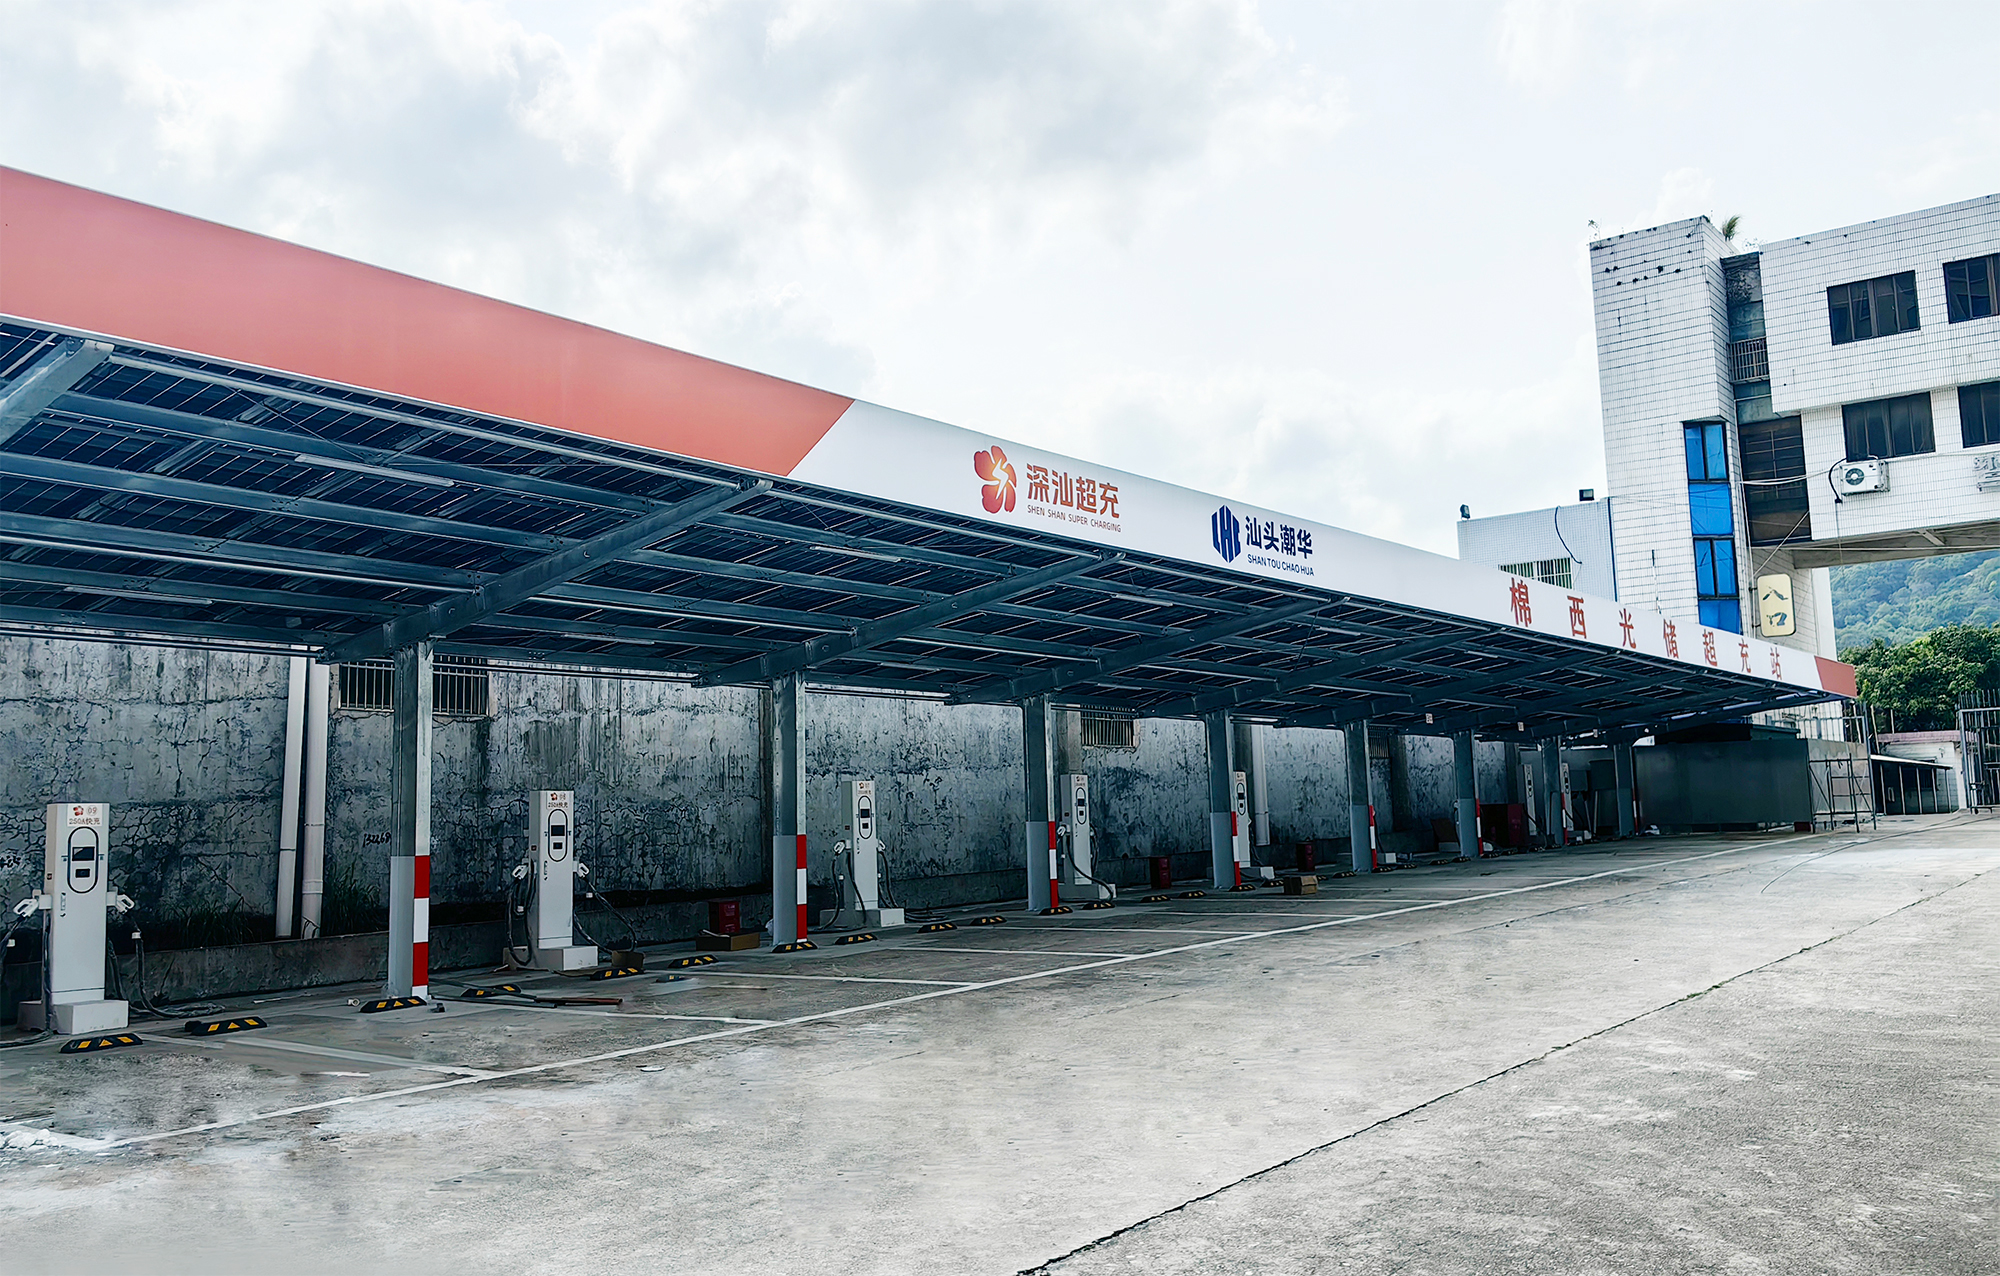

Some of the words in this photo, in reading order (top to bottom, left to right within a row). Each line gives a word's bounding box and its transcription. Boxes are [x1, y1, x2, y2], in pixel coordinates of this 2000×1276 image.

[1026, 463, 1120, 518] 深汕超充
[1027, 504, 1045, 517] SHEN
[1048, 509, 1066, 521] SHAN
[1068, 513, 1088, 526] SUPER
[1090, 518, 1122, 533] CHARGING
[1245, 515, 1313, 559] 汕头潮华
[1247, 553, 1267, 567] SHAN
[1266, 557, 1281, 570] TOU
[1281, 561, 1300, 573] CHAO
[1300, 565, 1315, 577] HUA
[1509, 577, 1783, 681] 棉西光储超充站
[69, 817, 100, 825] 250A快充
[87, 806, 98, 814] 09
